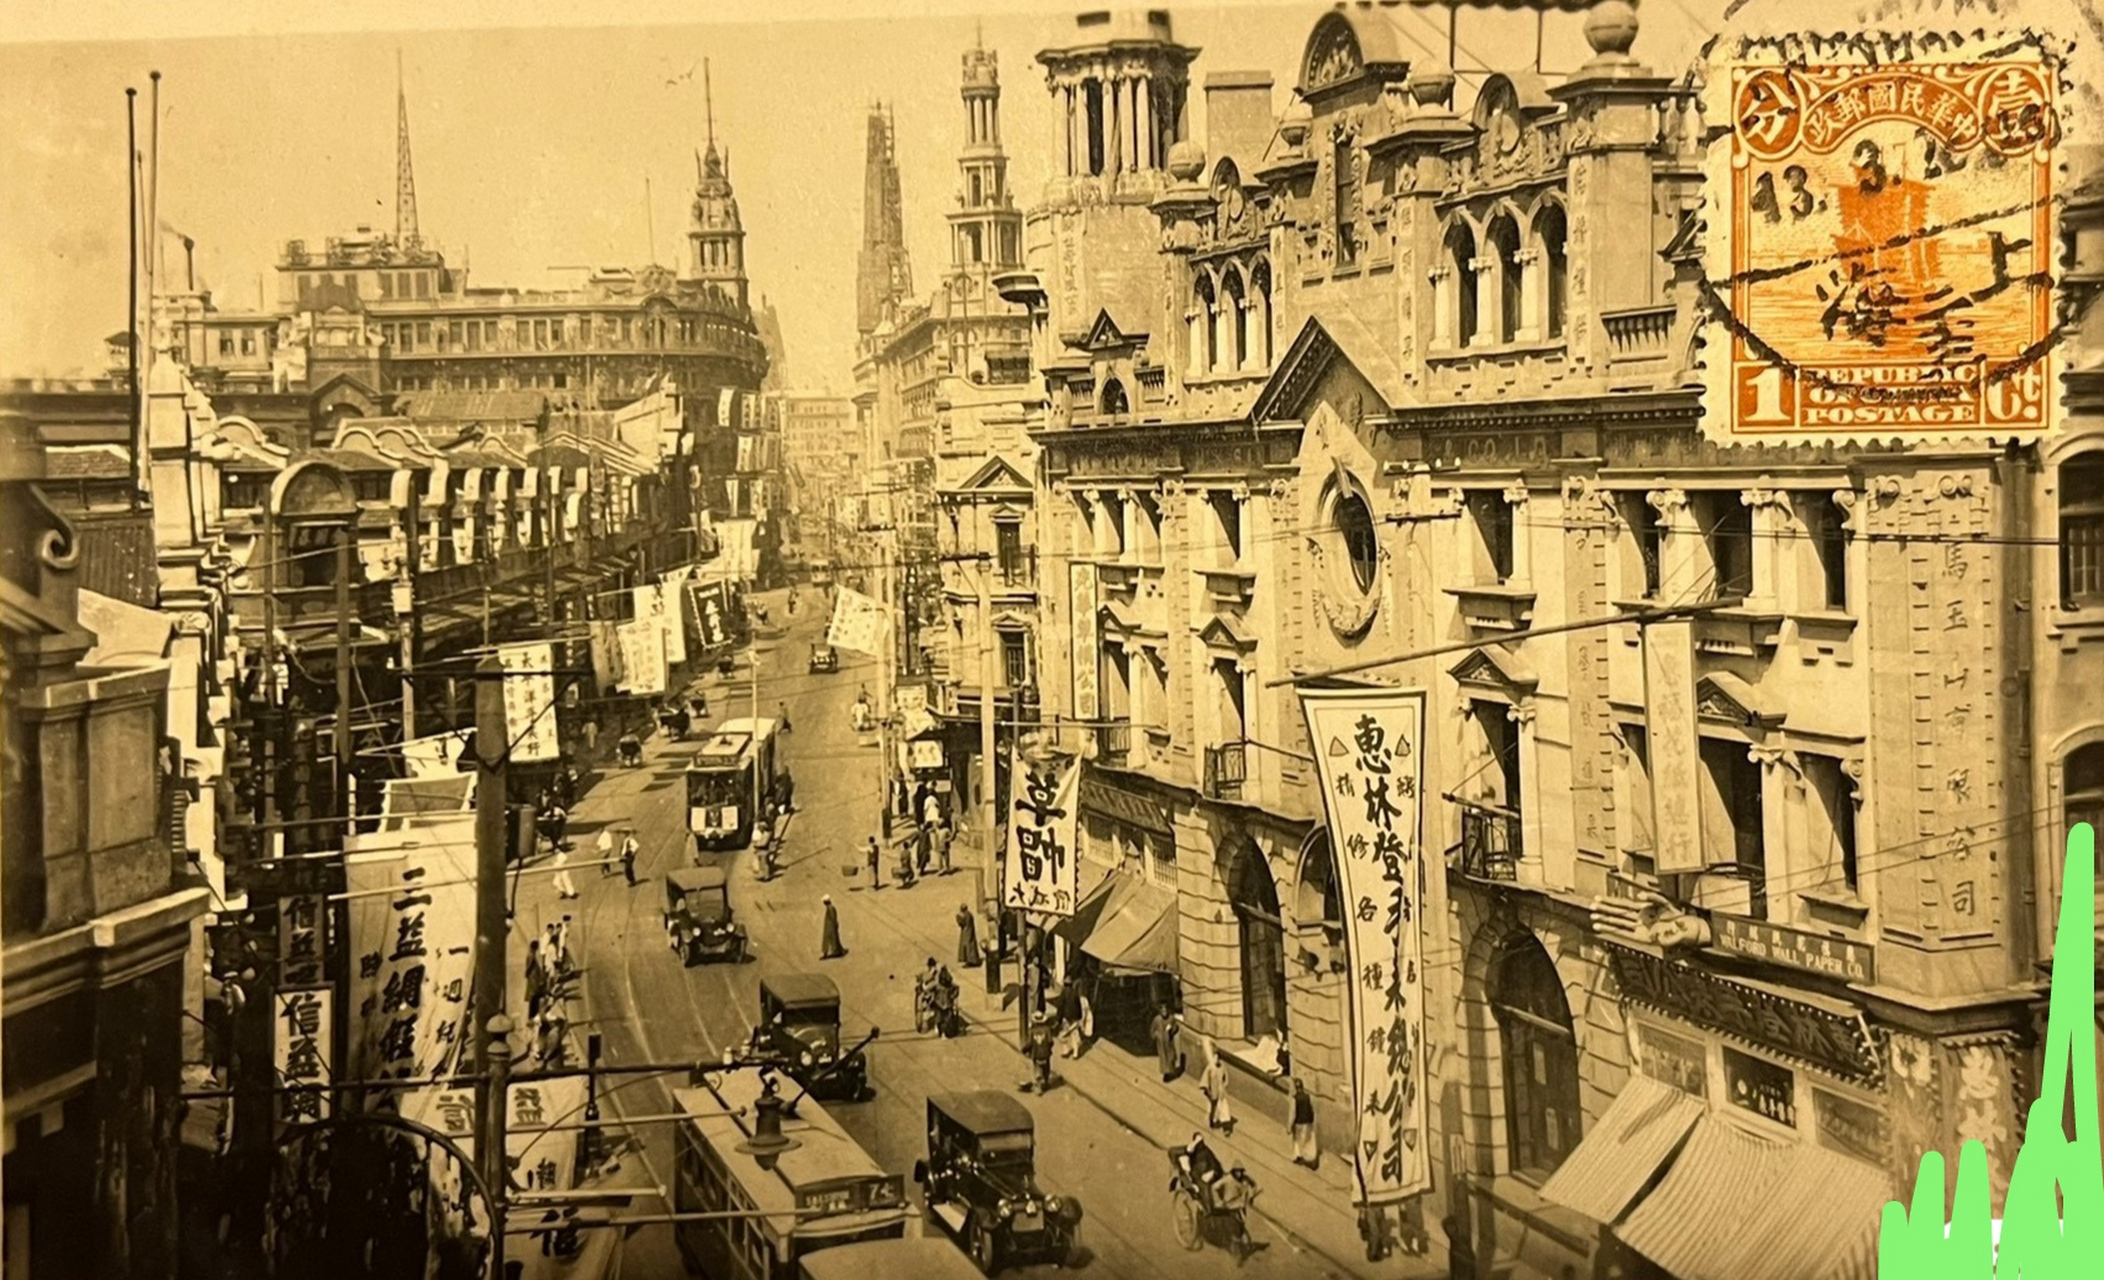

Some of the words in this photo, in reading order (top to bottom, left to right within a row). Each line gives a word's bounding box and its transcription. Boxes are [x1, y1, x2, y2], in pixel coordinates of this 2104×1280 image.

[1740, 76, 1798, 146] 分
[1742, 366, 1792, 422] 1
[1806, 405, 1975, 424] POSTAGE
[1805, 954, 1843, 975] PAPER
